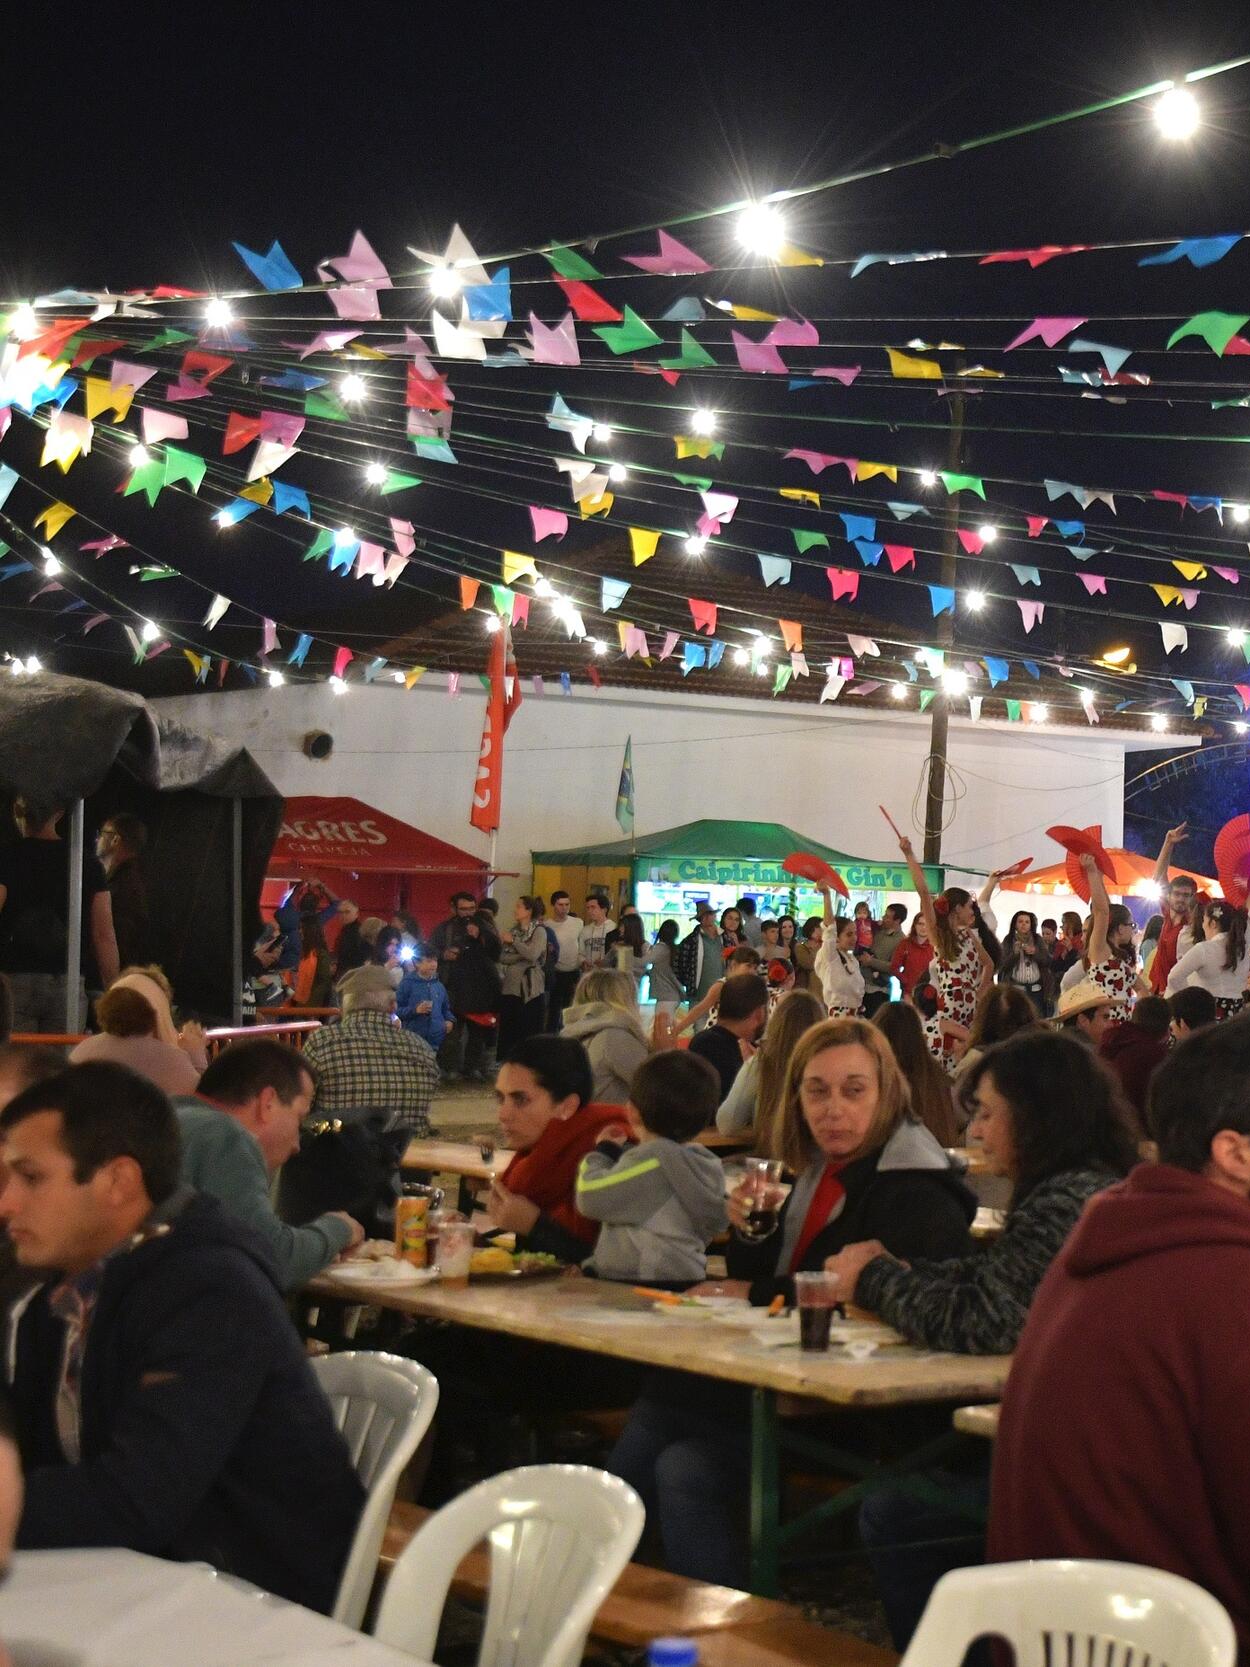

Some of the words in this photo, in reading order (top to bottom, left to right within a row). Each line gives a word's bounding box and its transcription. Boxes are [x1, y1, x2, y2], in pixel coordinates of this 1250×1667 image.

[278, 820, 388, 846] AGRES
[678, 860, 815, 884] Caipirinh
[846, 866, 903, 887] Gin's
